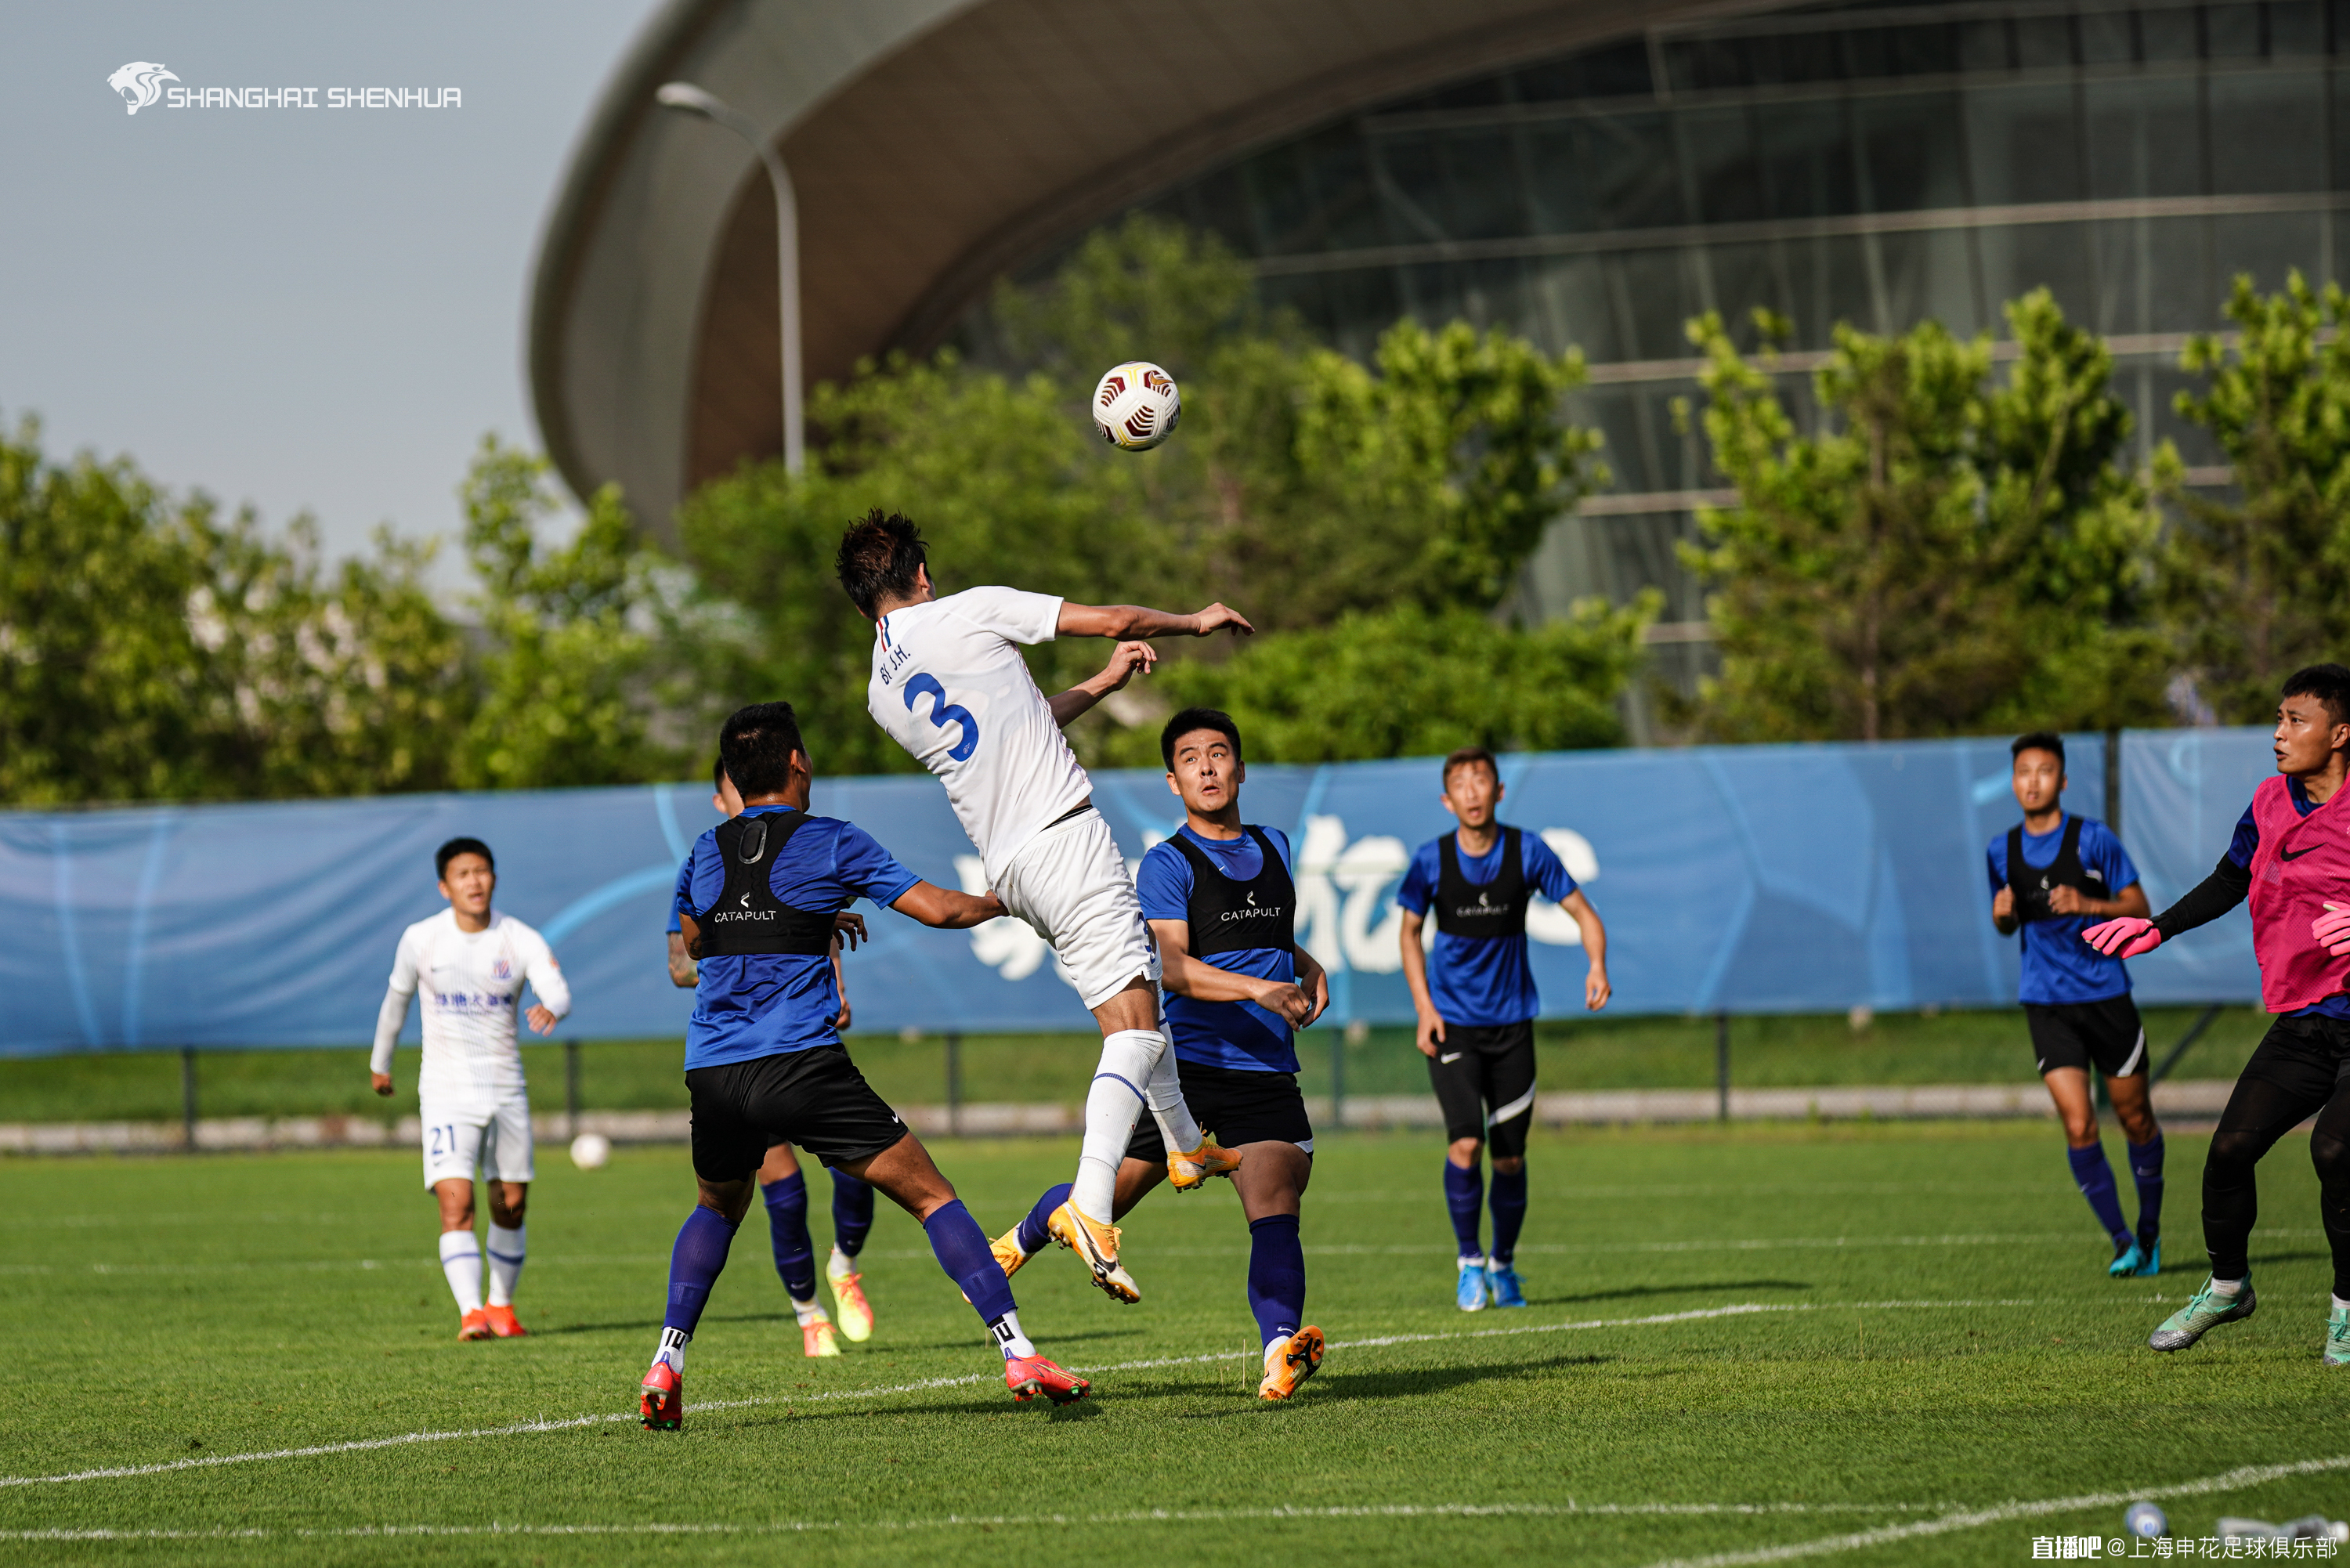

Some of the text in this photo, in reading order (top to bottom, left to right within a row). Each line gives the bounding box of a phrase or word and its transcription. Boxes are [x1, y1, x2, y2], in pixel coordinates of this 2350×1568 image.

[903, 672, 979, 762] 3
[714, 910, 776, 923] CATAPULT
[1220, 907, 1281, 922] CATAPULT
[430, 1123, 456, 1154] 21
